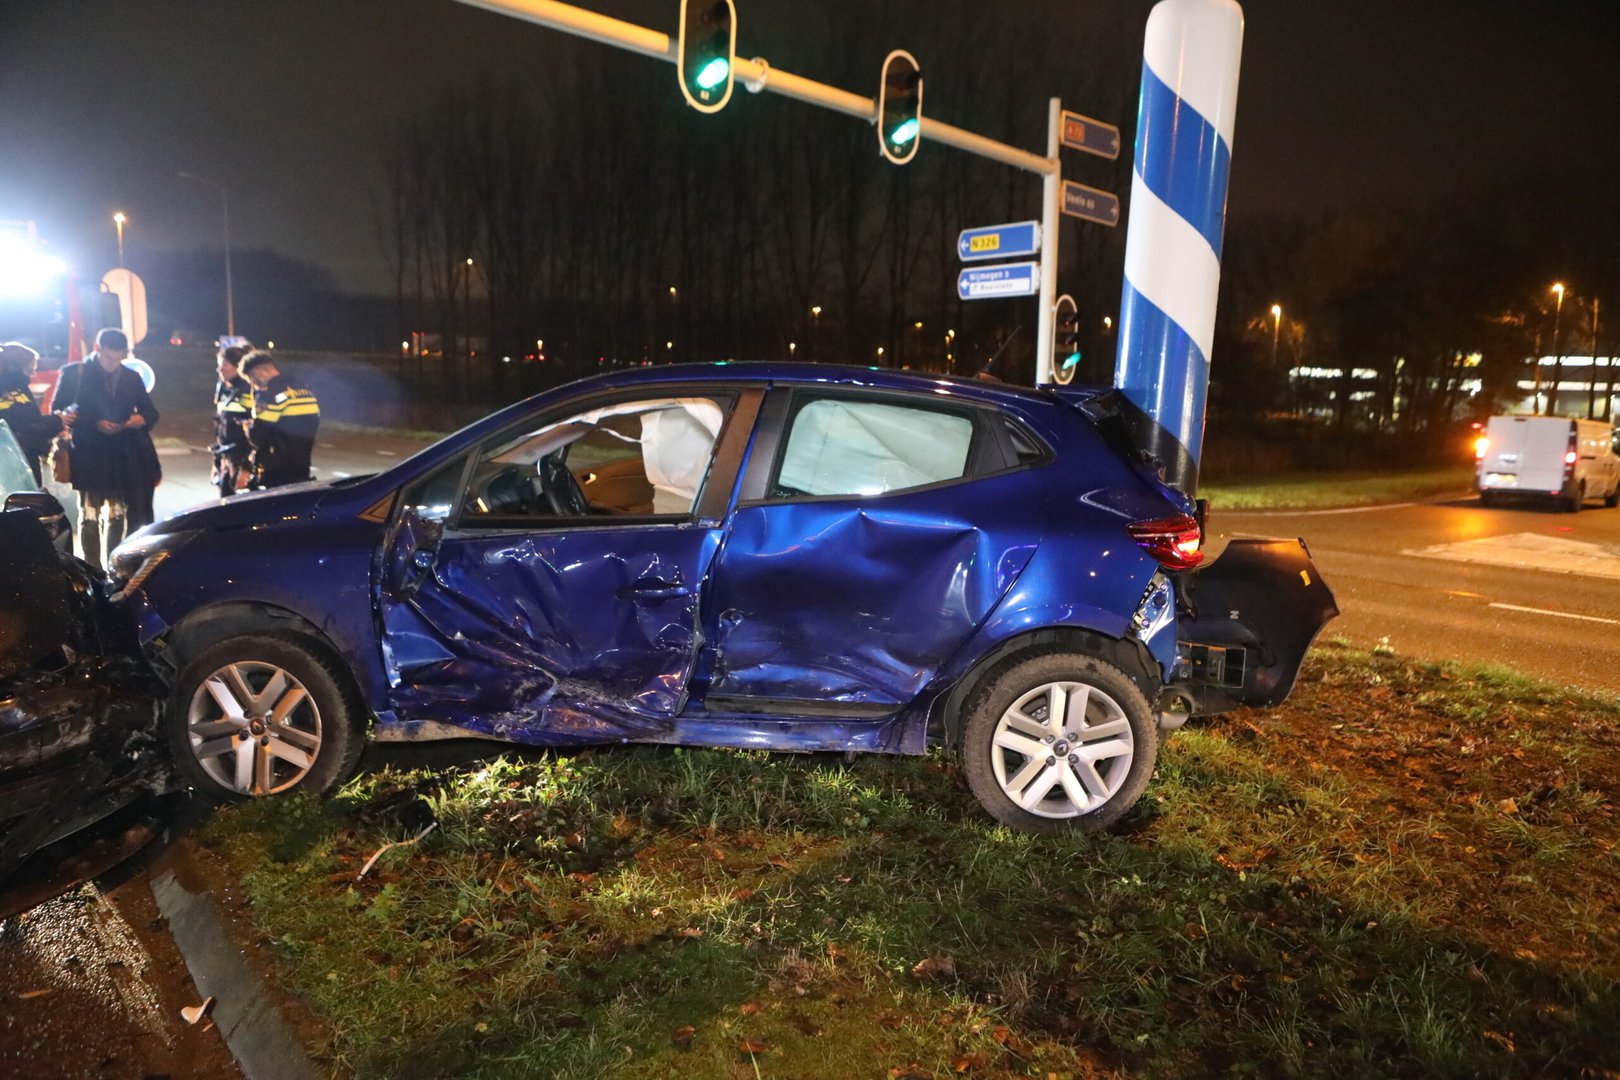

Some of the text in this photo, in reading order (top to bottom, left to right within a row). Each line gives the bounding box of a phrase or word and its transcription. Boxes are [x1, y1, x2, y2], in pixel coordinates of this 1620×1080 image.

[972, 236, 998, 249] N 326
[969, 271, 1003, 282] Nijmegen
